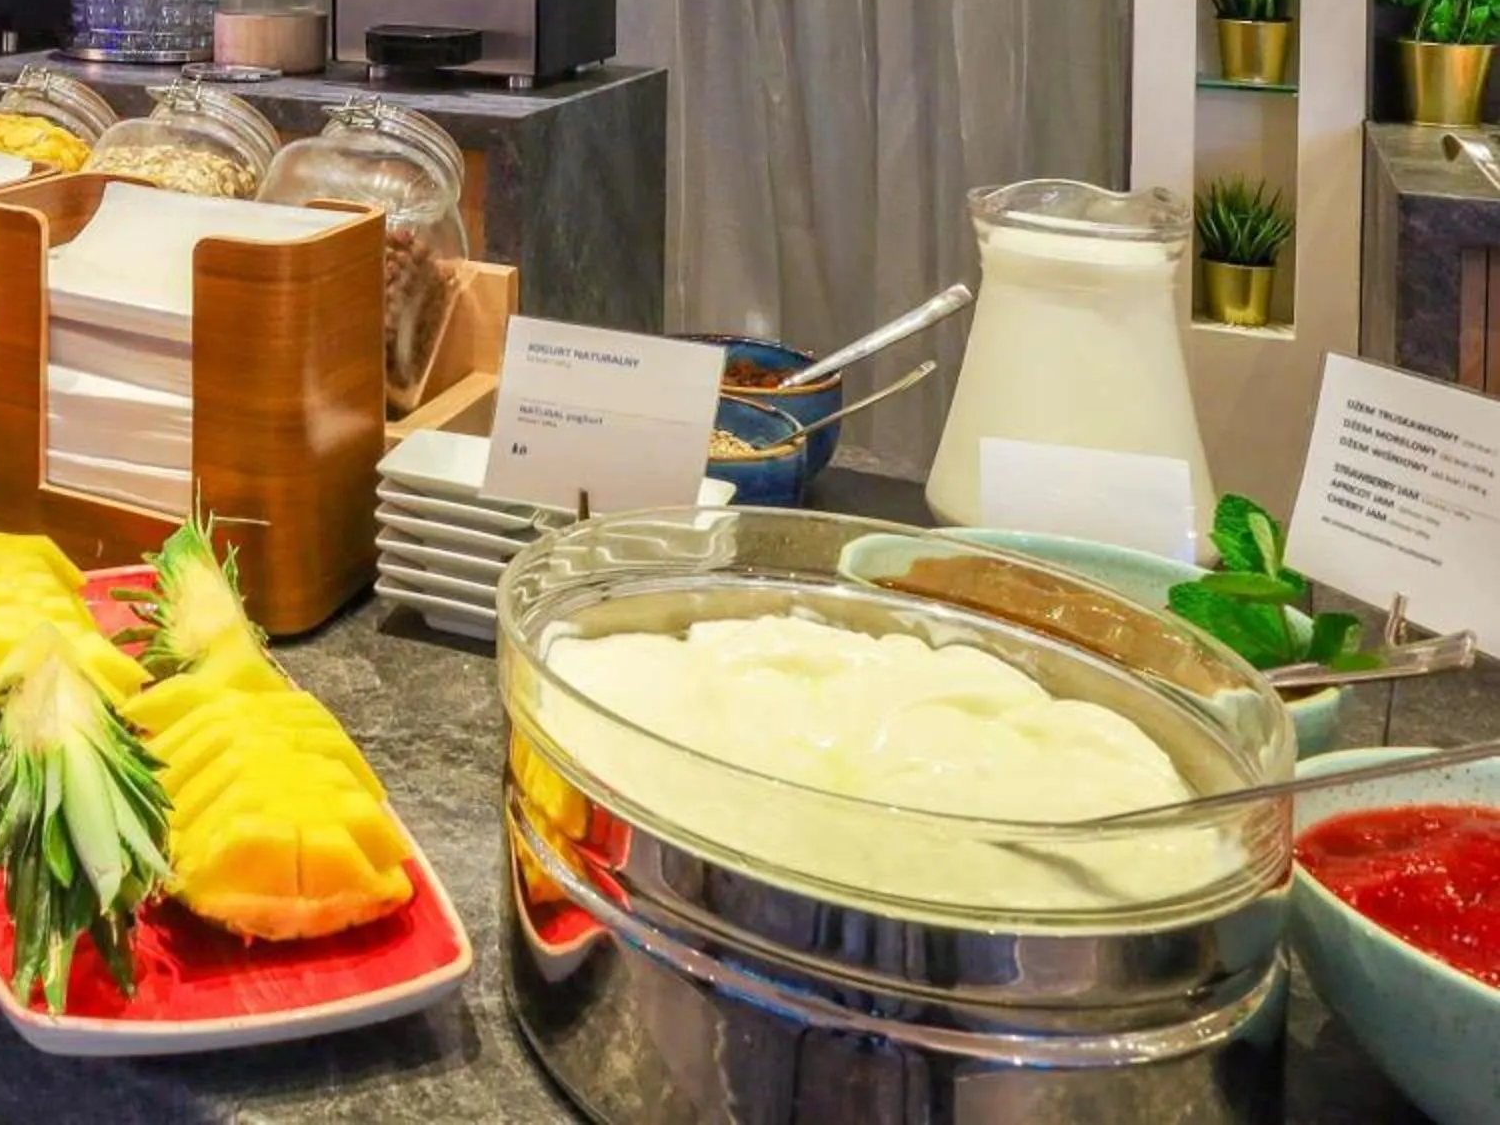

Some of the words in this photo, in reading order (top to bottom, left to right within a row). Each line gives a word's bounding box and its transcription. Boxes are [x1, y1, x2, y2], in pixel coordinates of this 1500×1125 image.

[573, 349, 640, 369] NATURALNY
[1375, 428, 1437, 456] MORELOWY
[1331, 478, 1372, 500] APRICOT
[1373, 494, 1395, 509] JAM
[1333, 462, 1396, 491] STRAWBERRY
[1397, 484, 1420, 500] JAM
[1327, 492, 1364, 513] CHERRY
[1365, 507, 1387, 522] JAM
